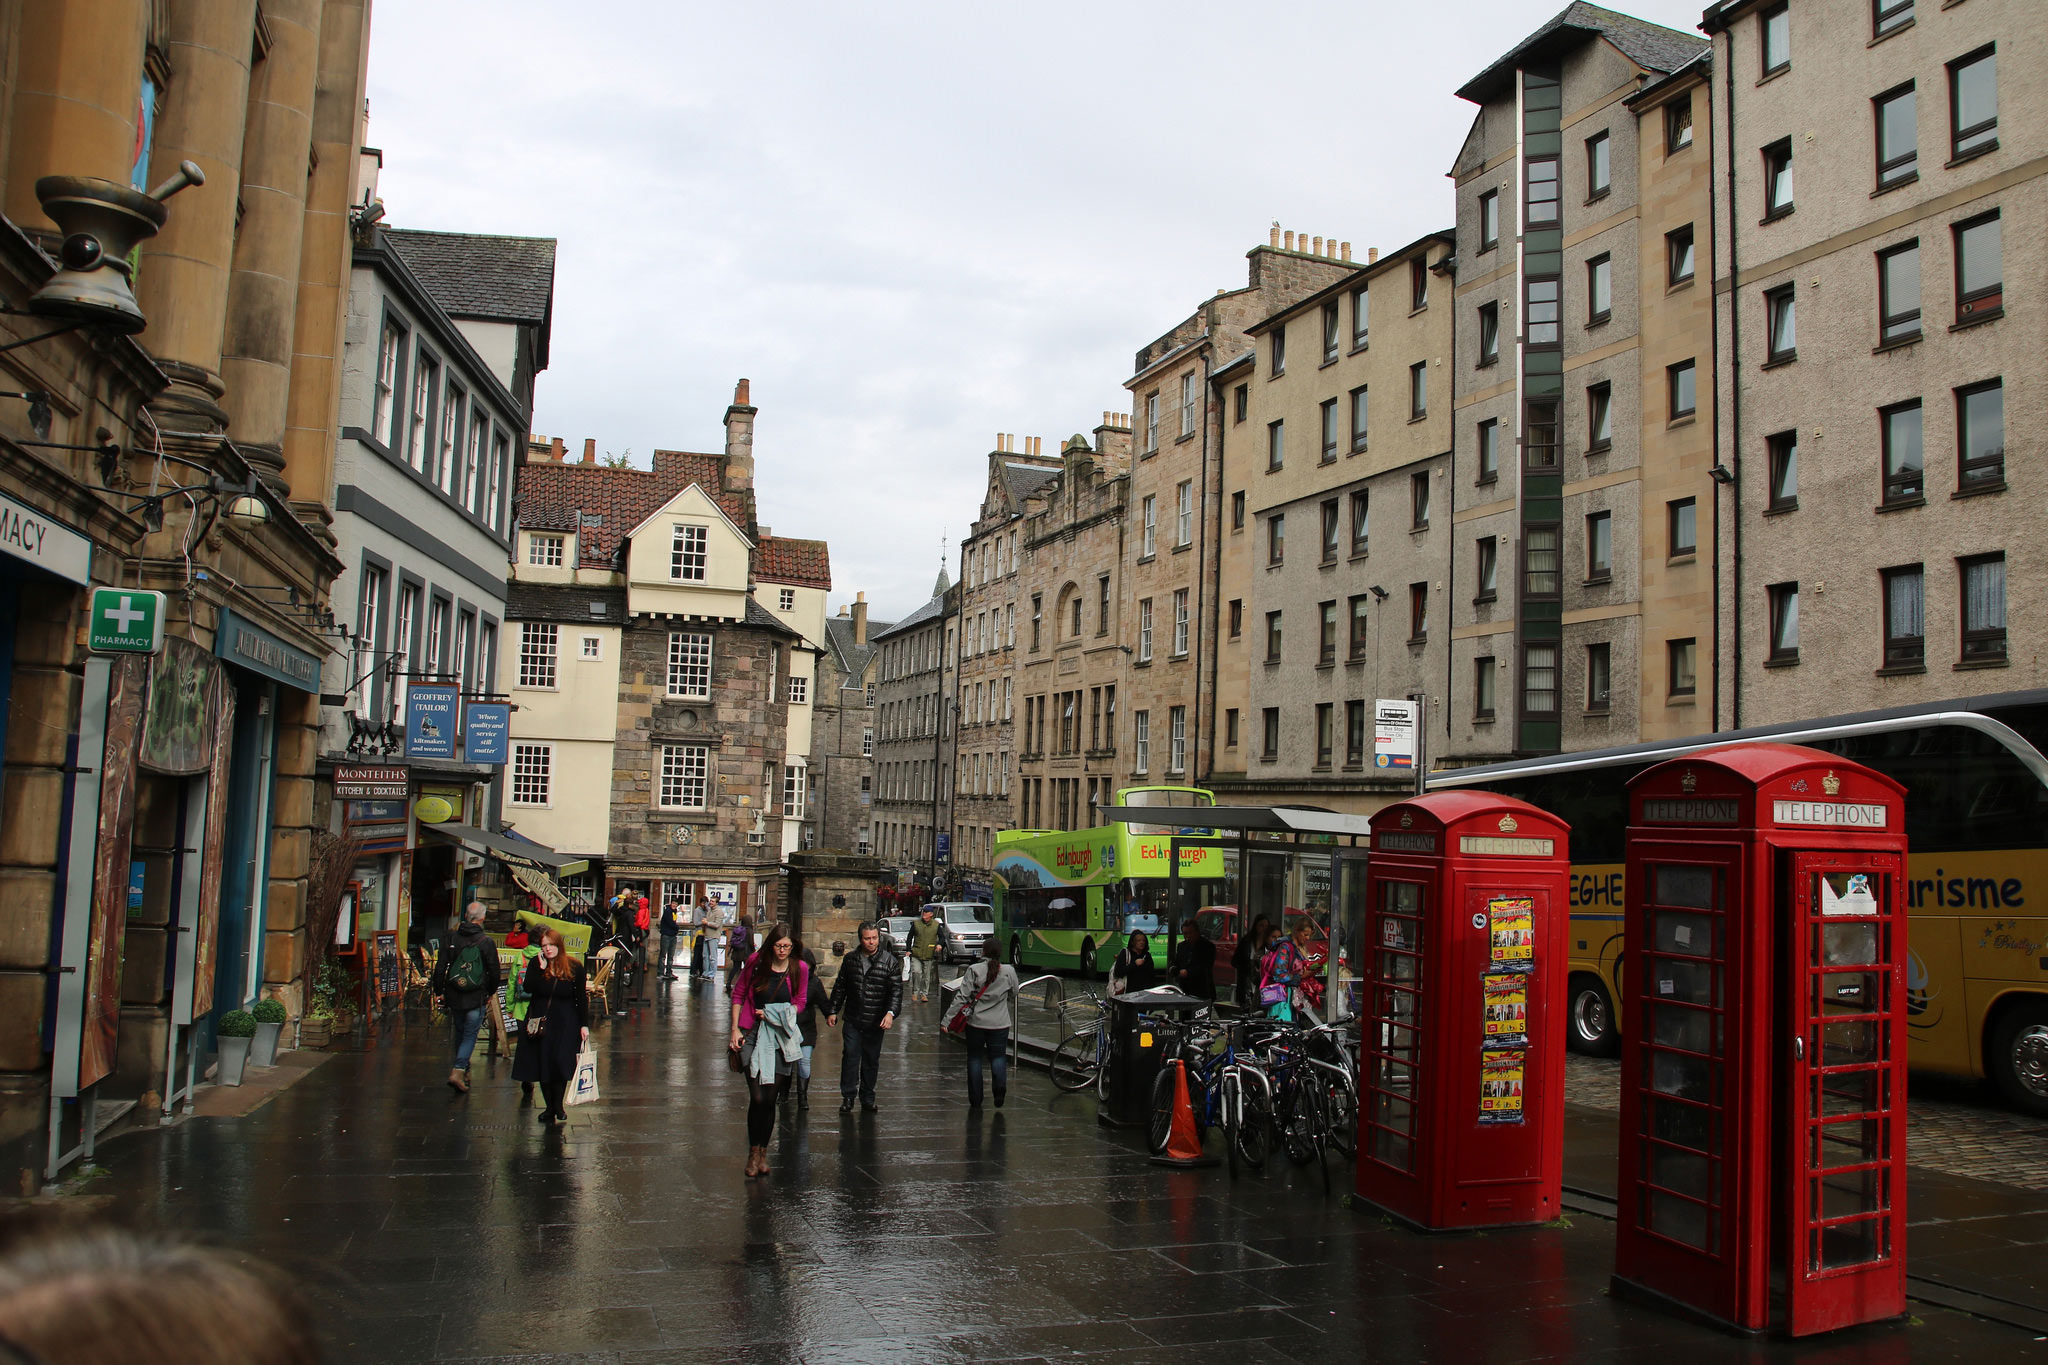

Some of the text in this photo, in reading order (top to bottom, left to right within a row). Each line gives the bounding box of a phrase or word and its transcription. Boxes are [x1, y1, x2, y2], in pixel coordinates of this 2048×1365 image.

[94, 635, 150, 647] PHARMACY
[412, 693, 453, 702] GEOFFREY
[415, 704, 449, 712] (TAILOR)
[337, 768, 407, 780] MONTEITHS
[336, 786, 407, 796] KITCHEN & COCKTAILS
[1649, 801, 1737, 820] TELEPHONE
[1777, 803, 1881, 825] TELEPHONE
[1382, 833, 1434, 850] TELEPHONE
[1462, 837, 1551, 855] TELEPHONE
[1140, 842, 1207, 864] Edinurgh
[1069, 865, 1084, 878] Tour
[1385, 922, 1395, 931] TO
[1384, 933, 1397, 943] LET
